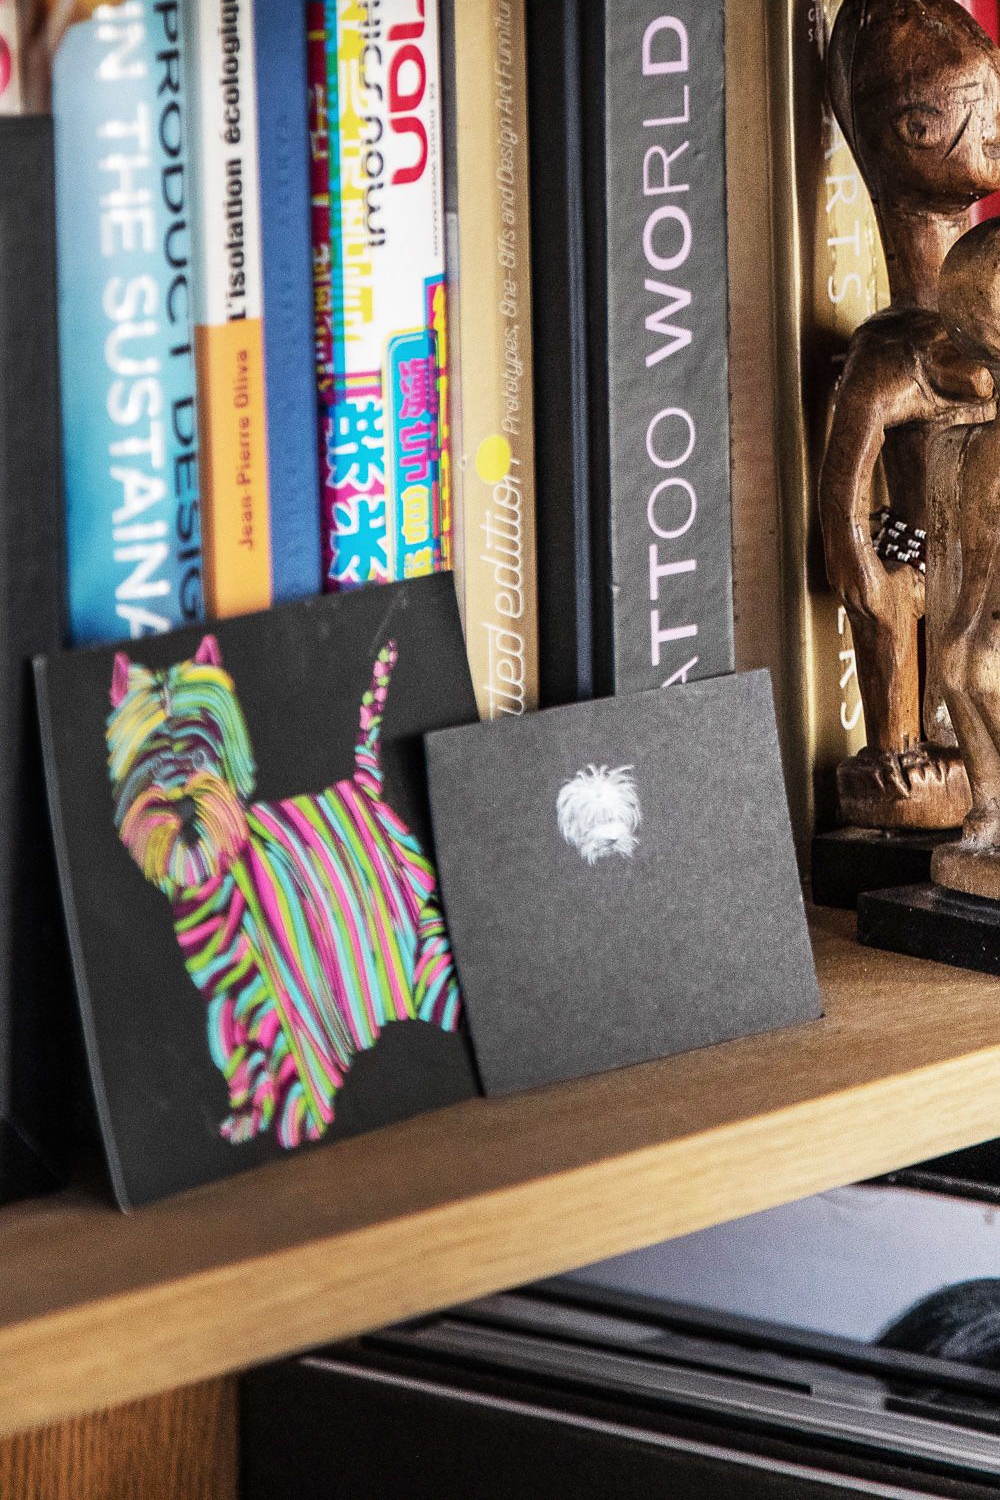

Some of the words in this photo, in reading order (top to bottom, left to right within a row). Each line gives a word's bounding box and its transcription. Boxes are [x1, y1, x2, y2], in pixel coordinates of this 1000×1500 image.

[93, 4, 145, 81] IN
[494, 83, 513, 114] Art
[495, 114, 518, 185] Design
[97, 102, 158, 257] THE
[360, 116, 386, 247] now!
[496, 186, 515, 225] and
[641, 15, 694, 368] WORLD
[224, 158, 248, 323] L'isolation
[497, 229, 517, 318] One-Offs
[231, 350, 251, 411] Oliva
[500, 324, 523, 434] Prototypes,
[100, 275, 174, 640] SUSTAINA
[172, 398, 203, 621] DESIG
[234, 418, 255, 550] Jean-Pierre
[481, 621, 524, 716] ited
